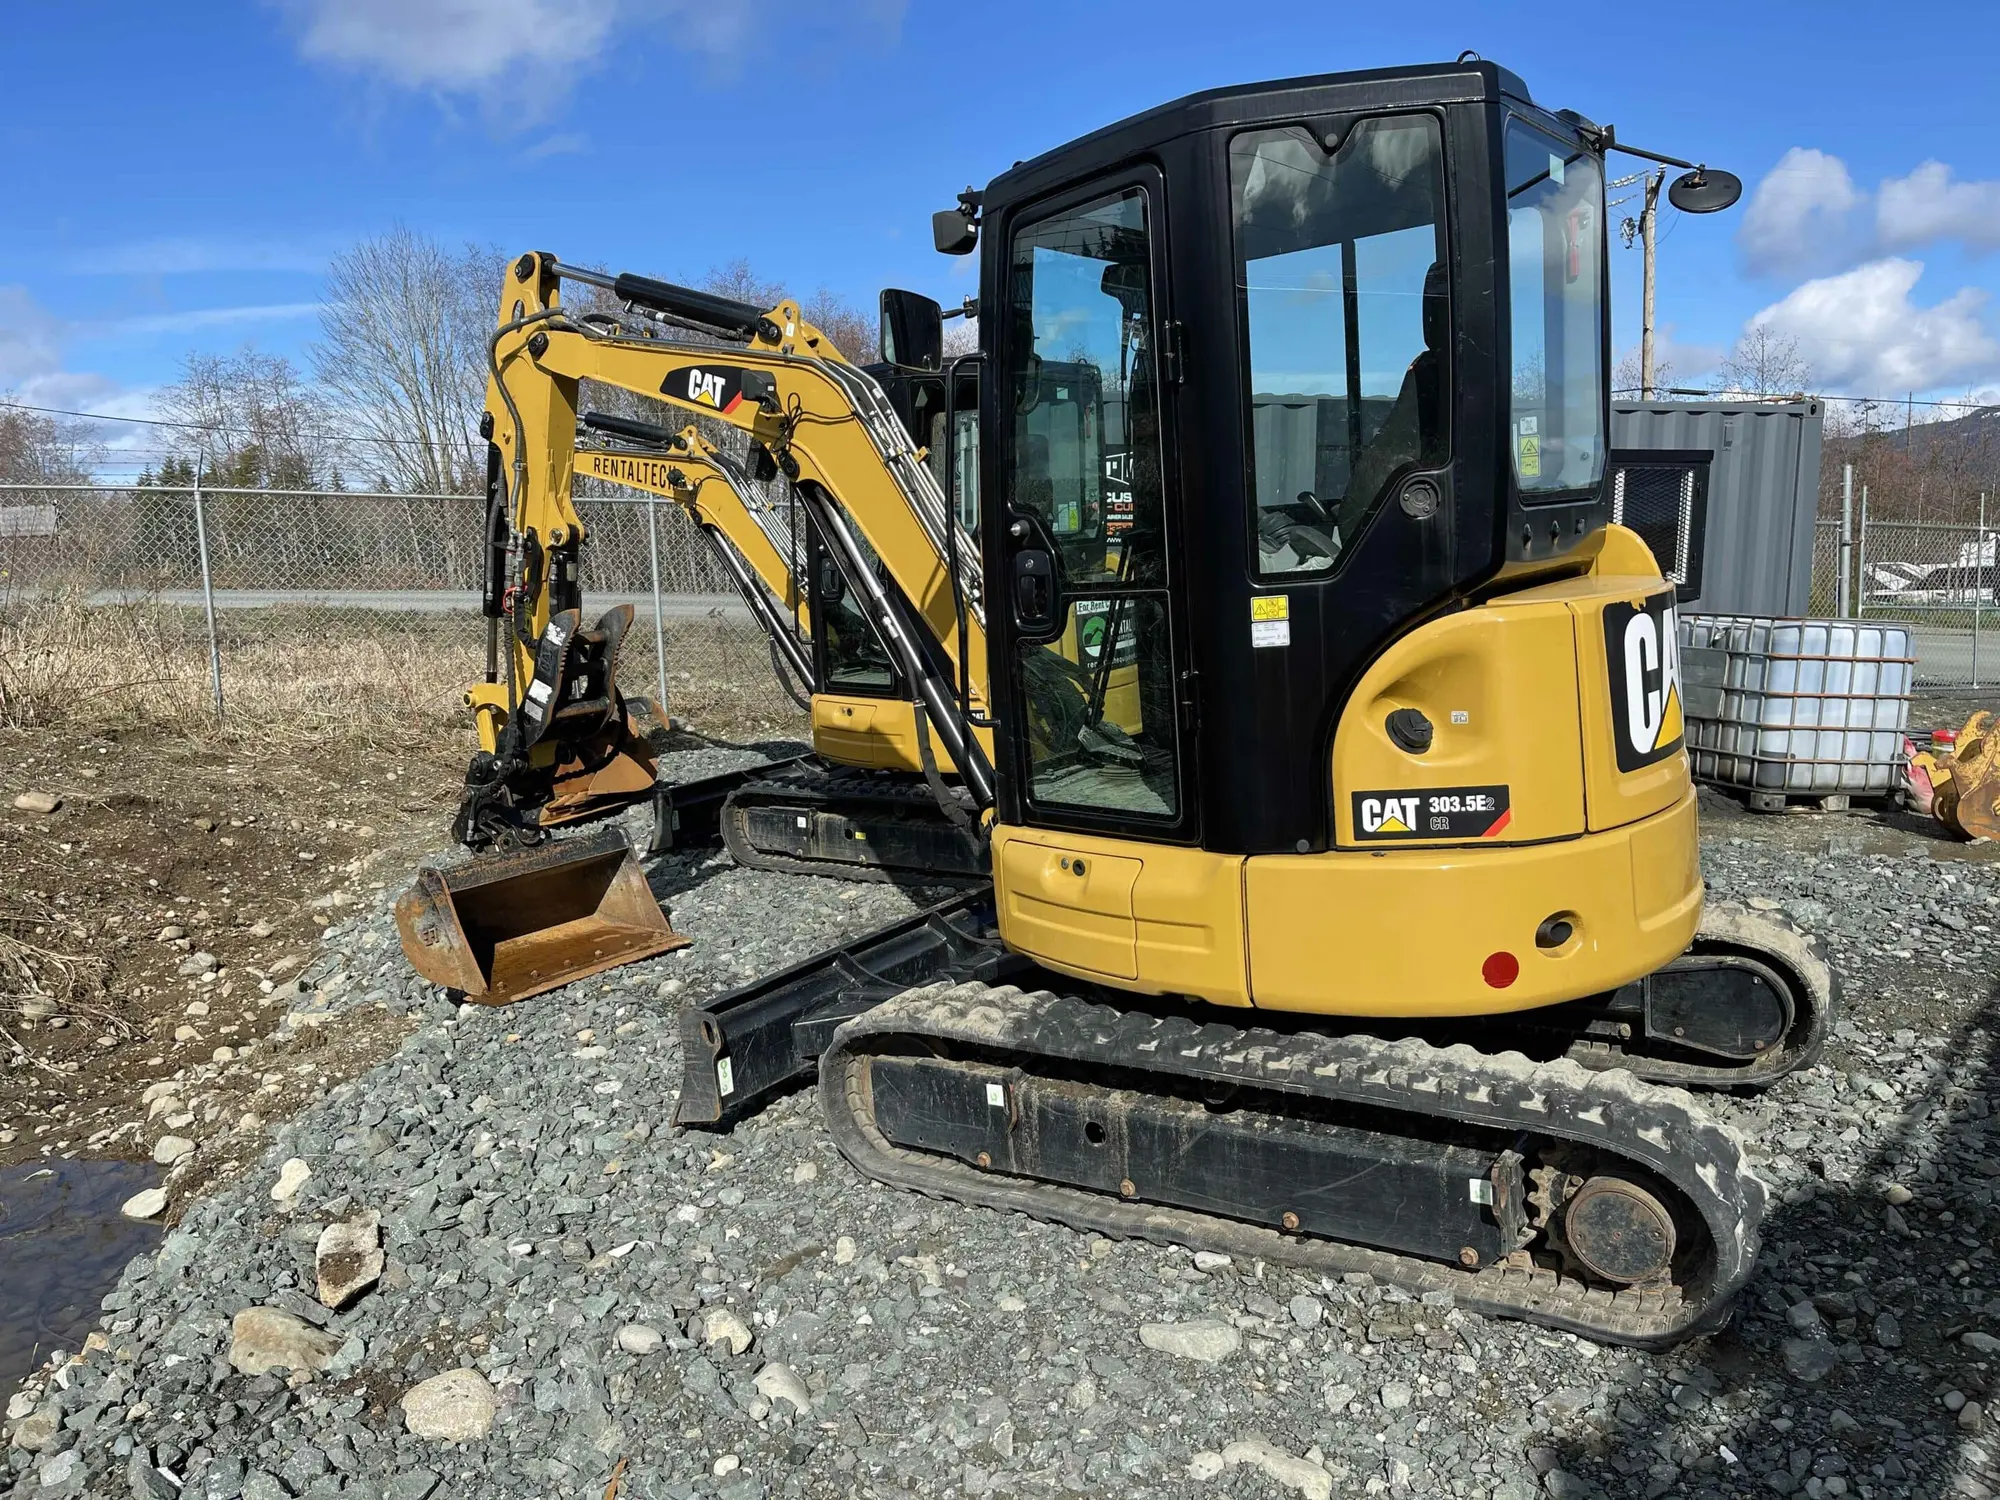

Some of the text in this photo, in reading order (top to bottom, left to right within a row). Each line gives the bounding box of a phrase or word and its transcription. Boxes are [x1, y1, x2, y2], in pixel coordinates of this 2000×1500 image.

[688, 369, 726, 408] CAT
[1078, 602, 1089, 612] For
[1090, 601, 1104, 610] Rent
[1624, 604, 1683, 754] CA
[1361, 797, 1420, 833] CAT
[1429, 816, 1450, 831] CR
